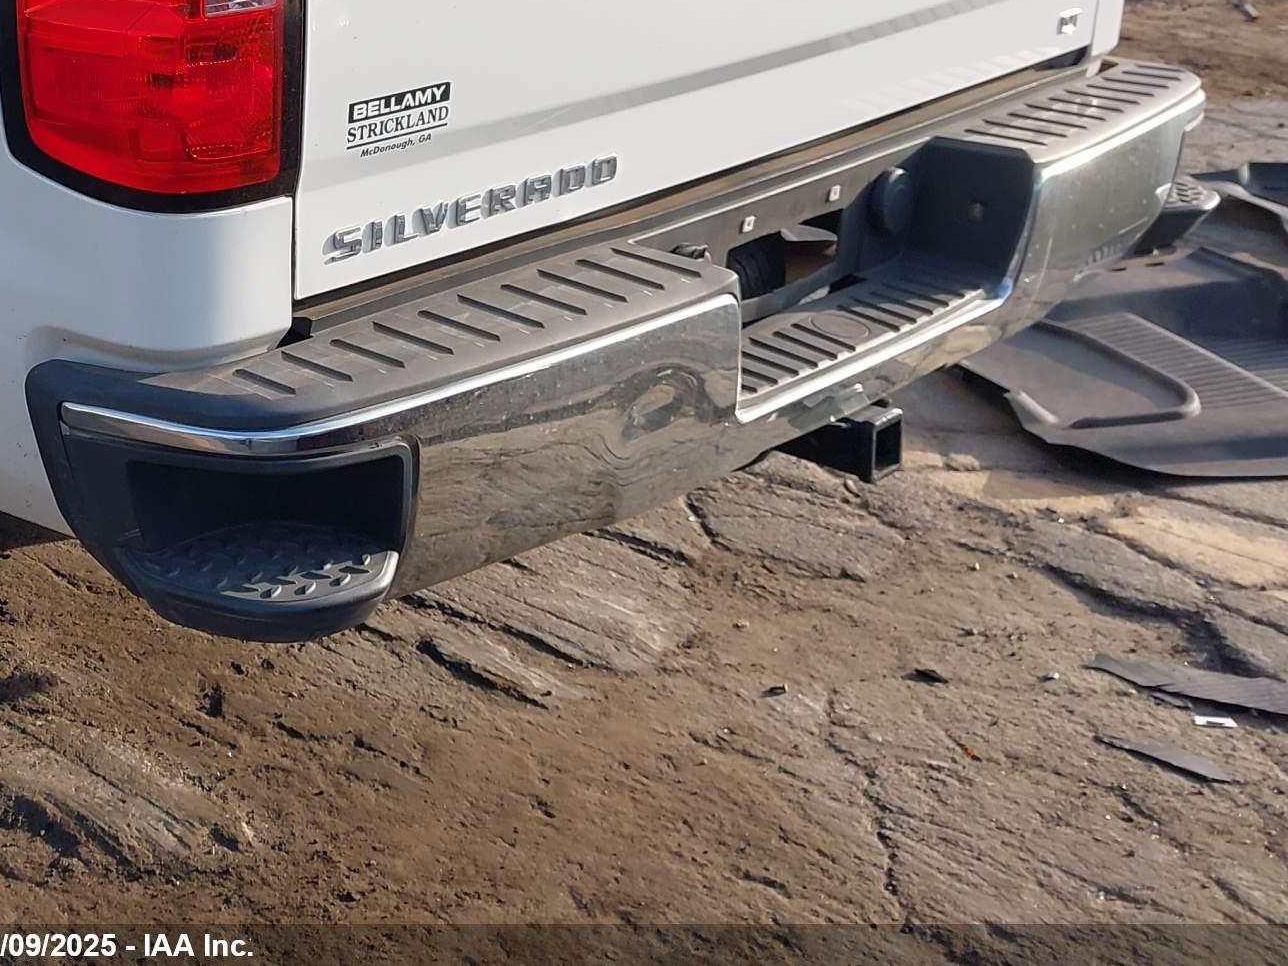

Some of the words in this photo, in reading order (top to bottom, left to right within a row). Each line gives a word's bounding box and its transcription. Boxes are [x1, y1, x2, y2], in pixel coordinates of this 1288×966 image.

[352, 84, 447, 121] BELLAMY
[346, 105, 449, 144] STRICKLAND
[360, 137, 416, 158] McDonough,
[418, 133, 432, 143] GA
[322, 154, 619, 266] SILVERADO
